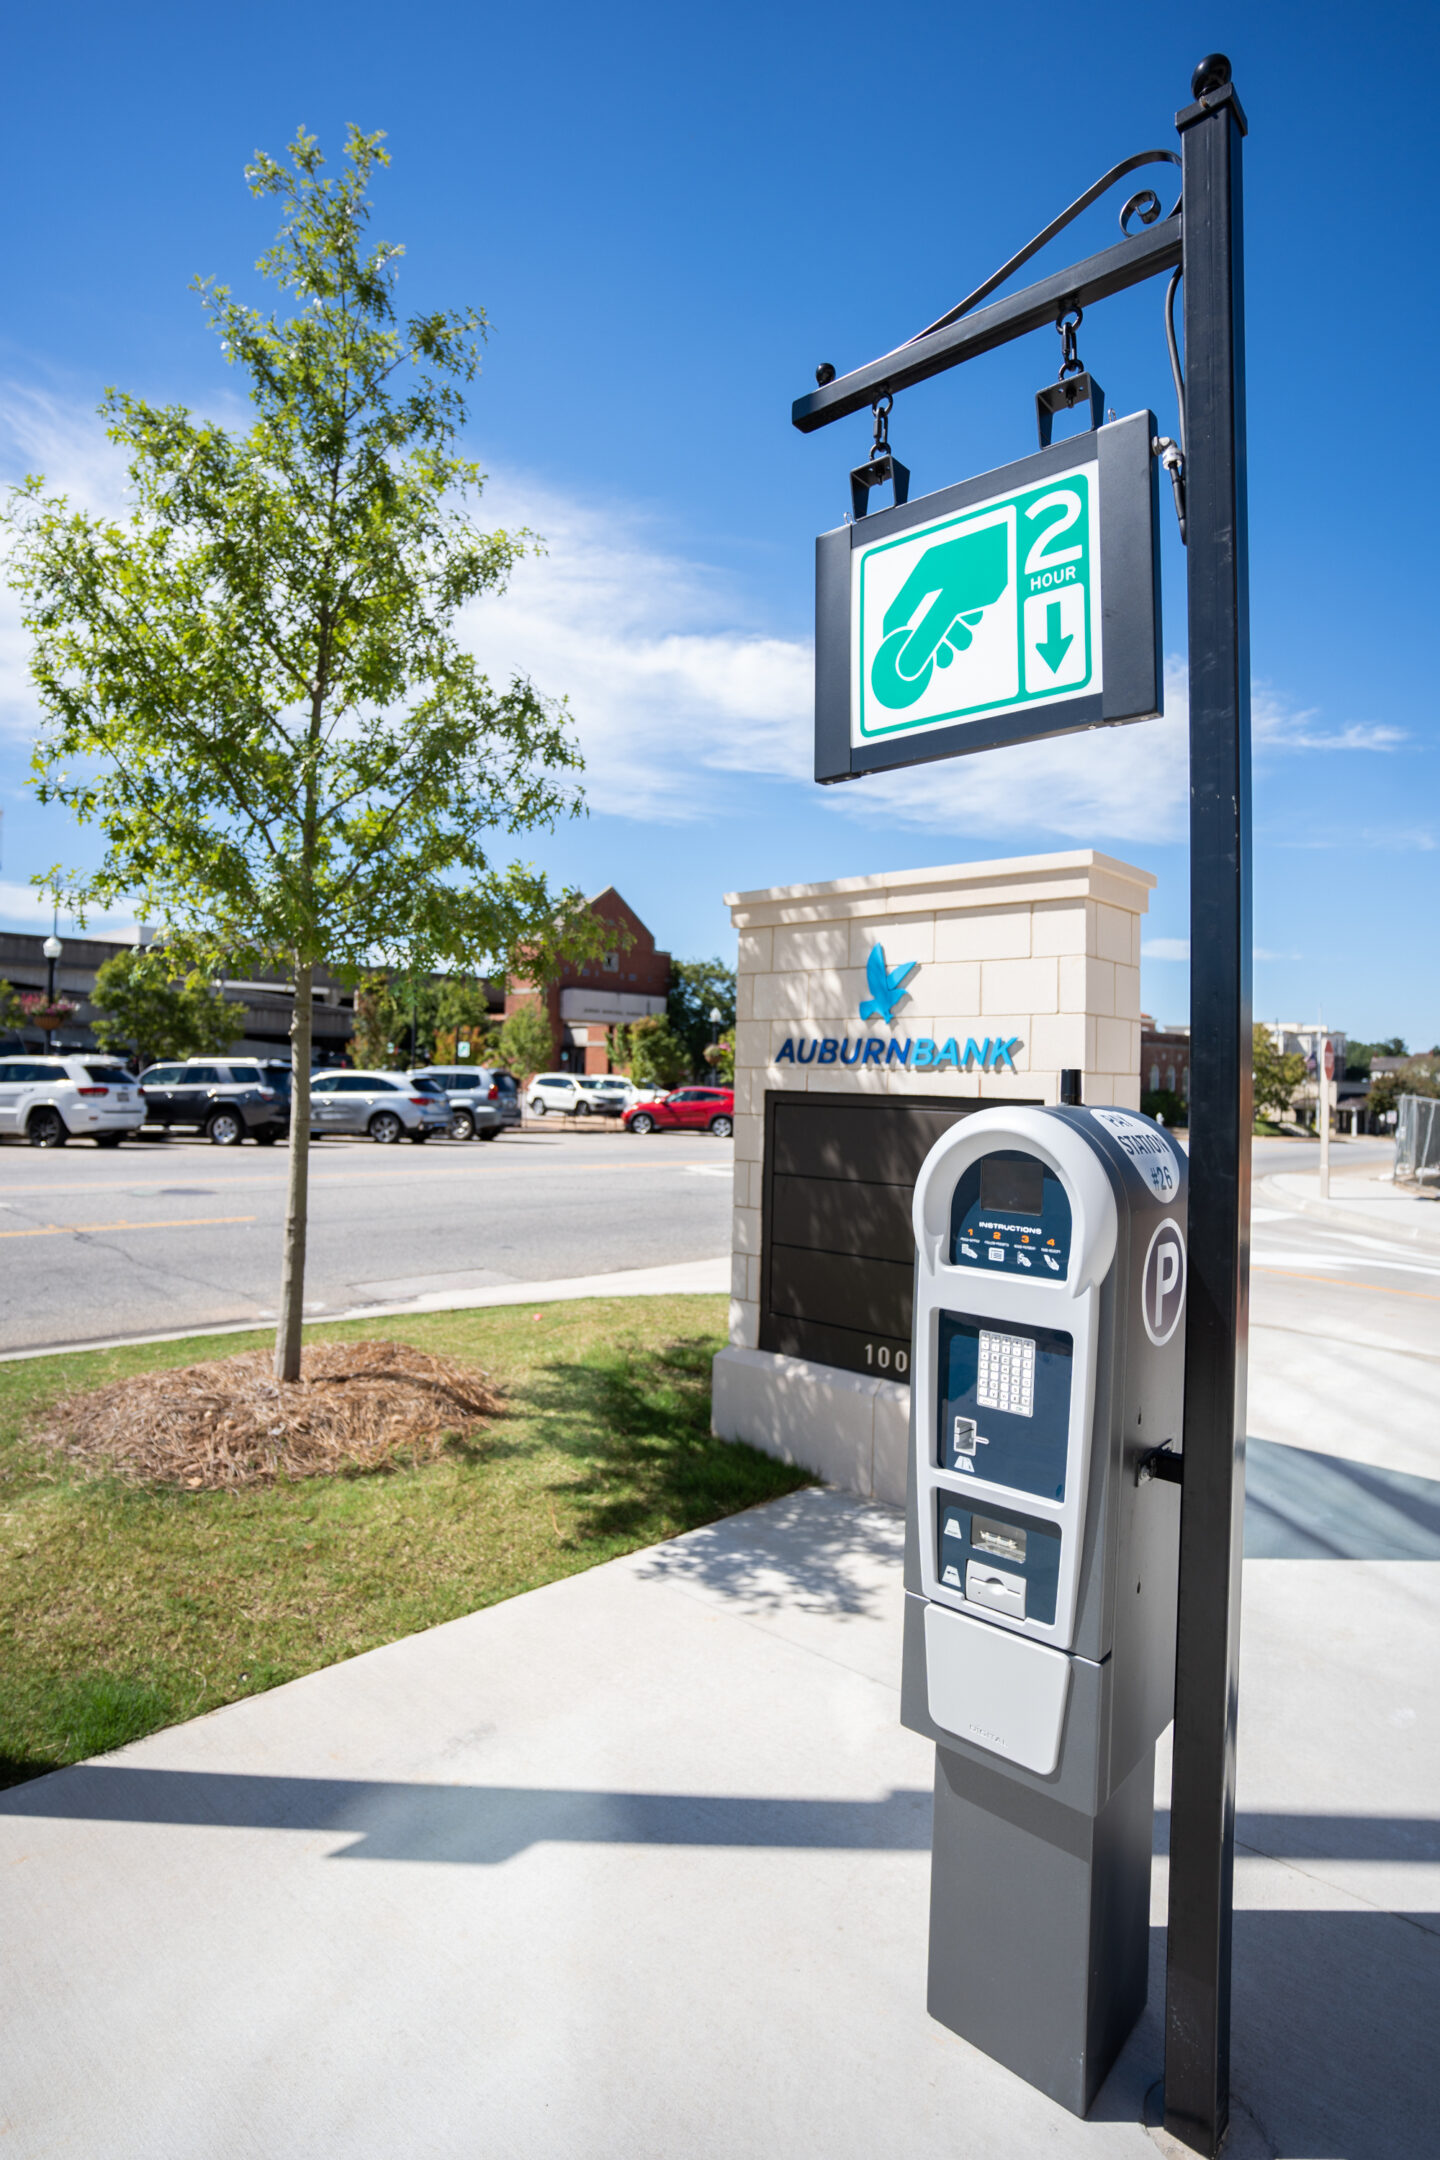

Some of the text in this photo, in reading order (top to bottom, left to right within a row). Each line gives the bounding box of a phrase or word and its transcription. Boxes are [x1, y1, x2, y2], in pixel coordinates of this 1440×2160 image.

[1024, 489, 1083, 575] 2
[1030, 565, 1076, 592] HOUR
[775, 1036, 1018, 1067] AUBURNBANK
[1117, 1134, 1170, 1156] STATION
[1150, 1166, 1173, 1191] #26
[967, 1228, 974, 1236] 1
[993, 1231, 1001, 1240] 2
[1020, 1234, 1030, 1244] 3
[1046, 1238, 1055, 1247] 4
[978, 1221, 1042, 1235] INSTRUCTIONS
[1155, 1241, 1180, 1328] P
[864, 1343, 908, 1373] 100
